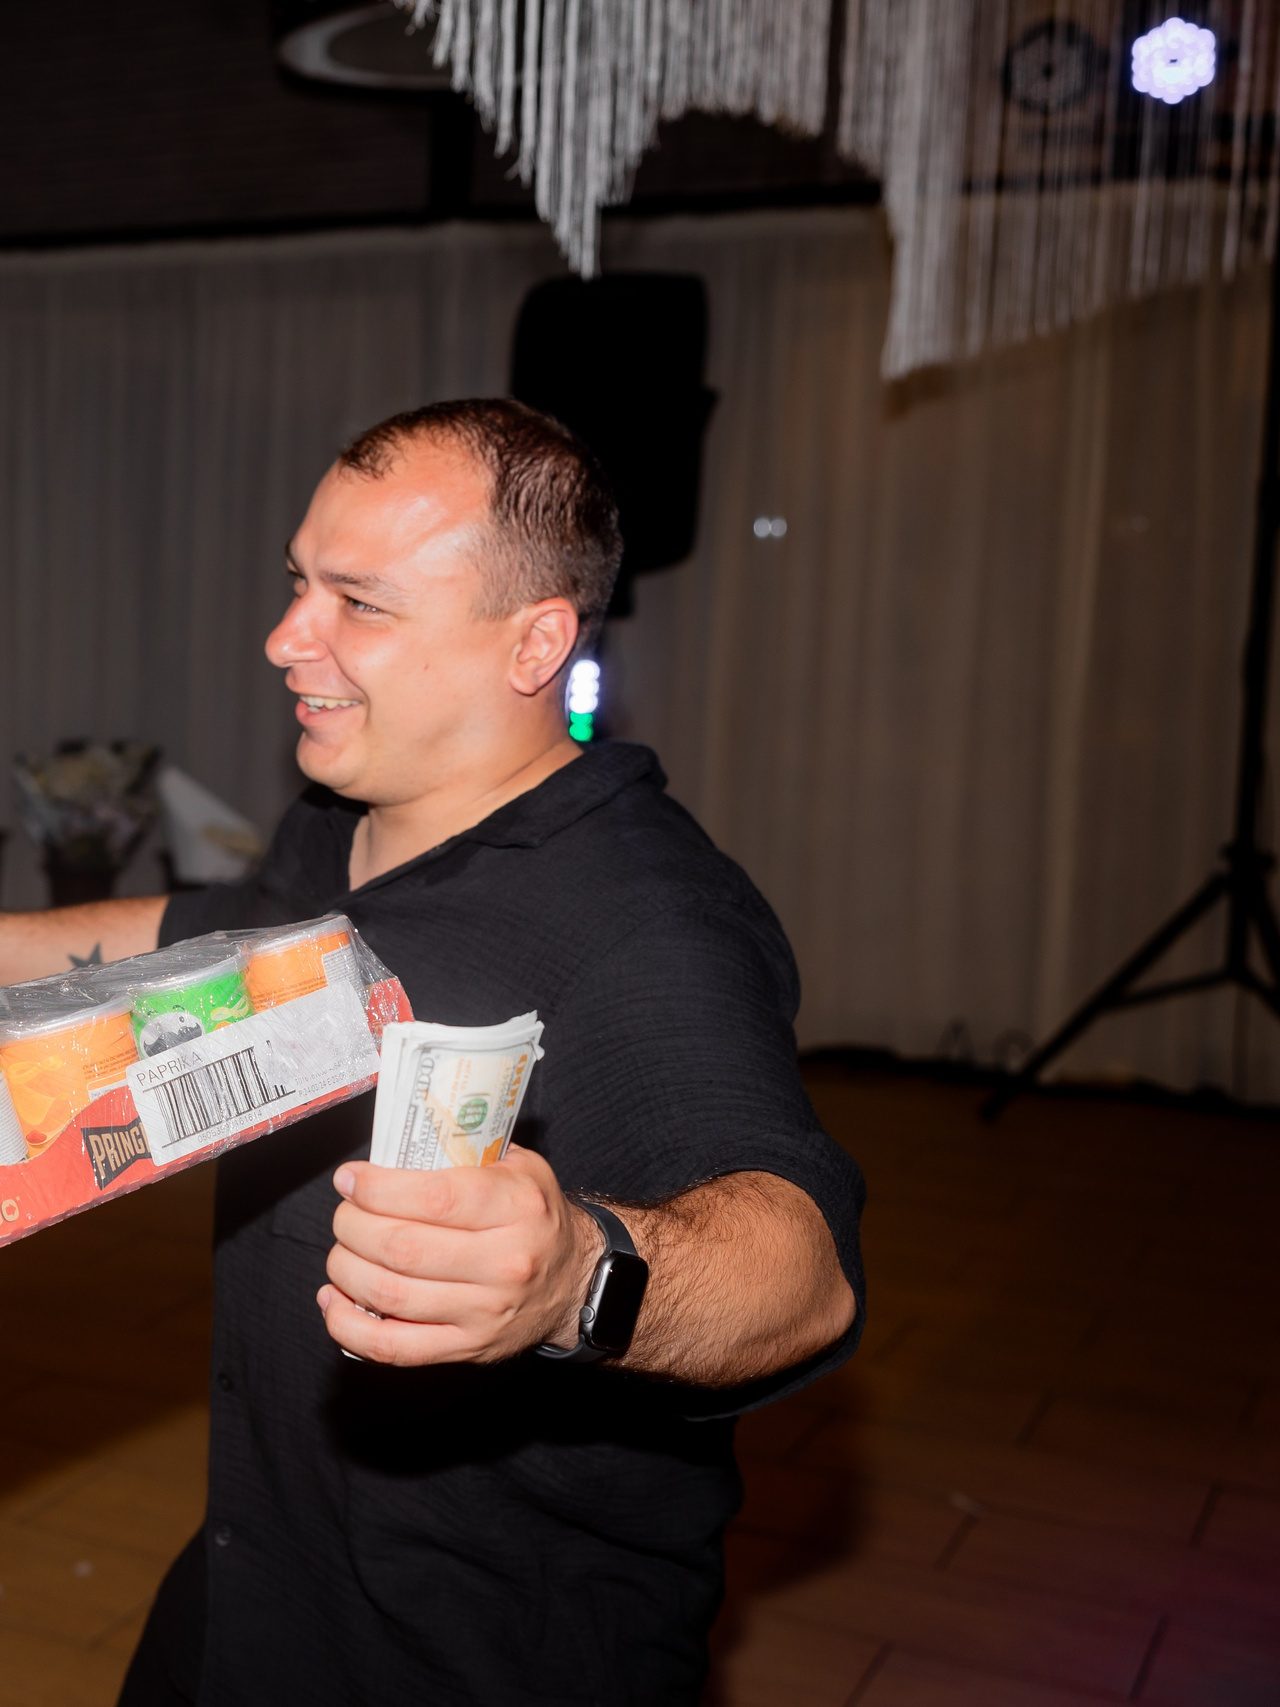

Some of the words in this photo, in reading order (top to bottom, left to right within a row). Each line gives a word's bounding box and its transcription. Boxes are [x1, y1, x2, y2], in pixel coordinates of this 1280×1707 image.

[135, 1050, 205, 1086] PAPRIKA
[414, 1056, 437, 1101] 100
[506, 1053, 529, 1109] 100
